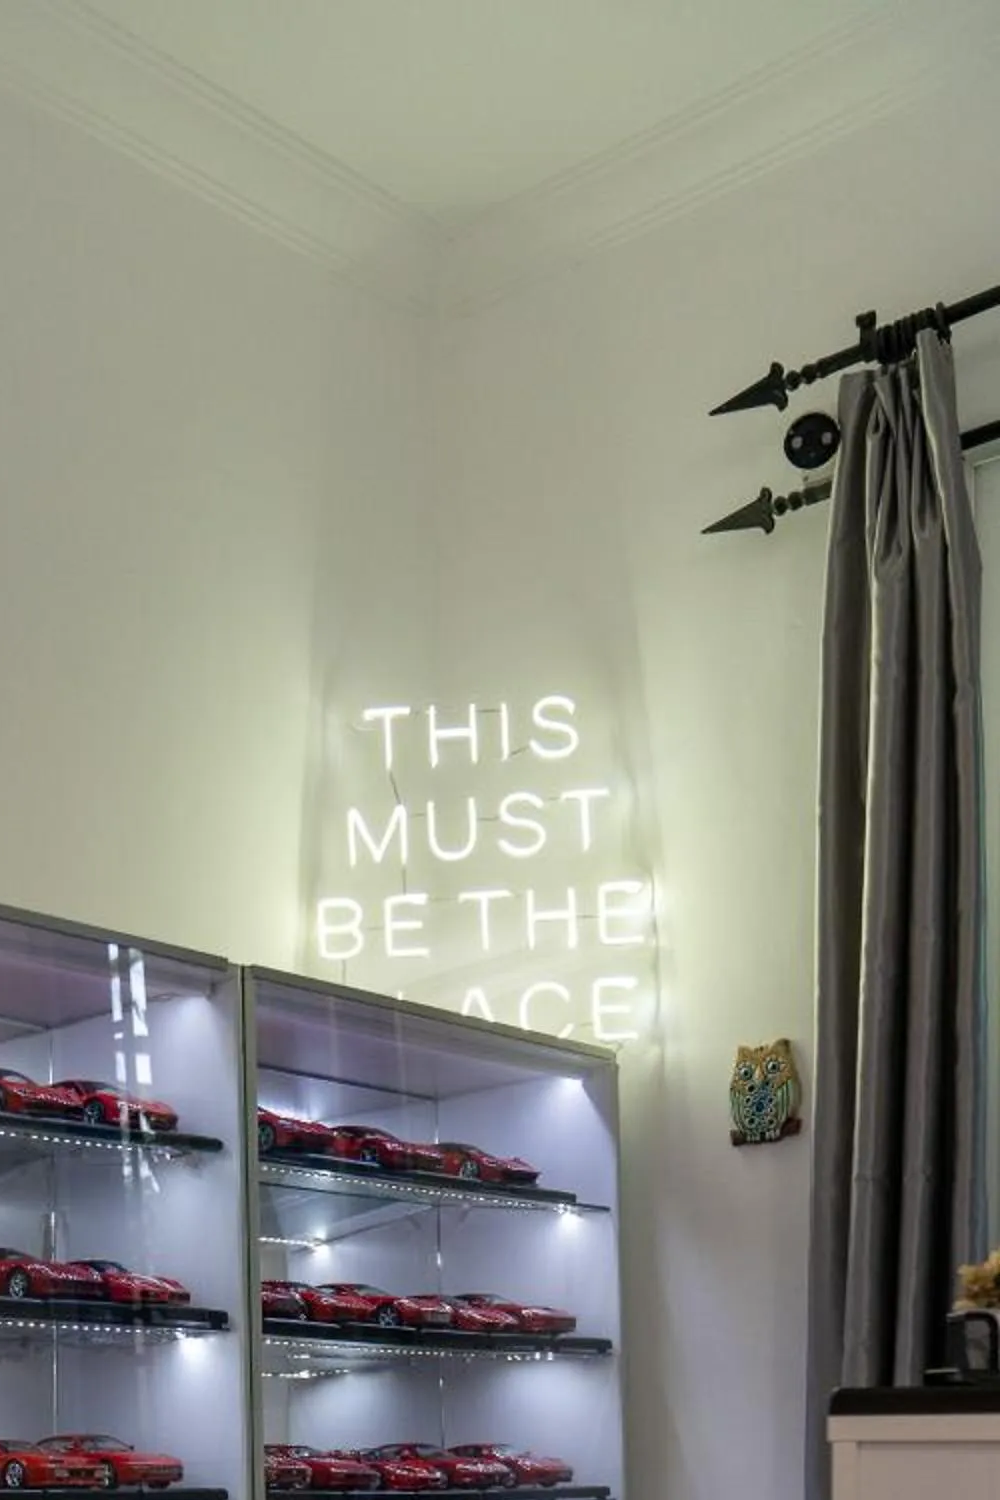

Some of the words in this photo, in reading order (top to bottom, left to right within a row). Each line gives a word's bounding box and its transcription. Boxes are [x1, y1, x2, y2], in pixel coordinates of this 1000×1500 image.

[362, 695, 580, 769] THIS
[346, 787, 610, 868] MUST
[317, 892, 431, 960] BE
[457, 880, 646, 951] THE
